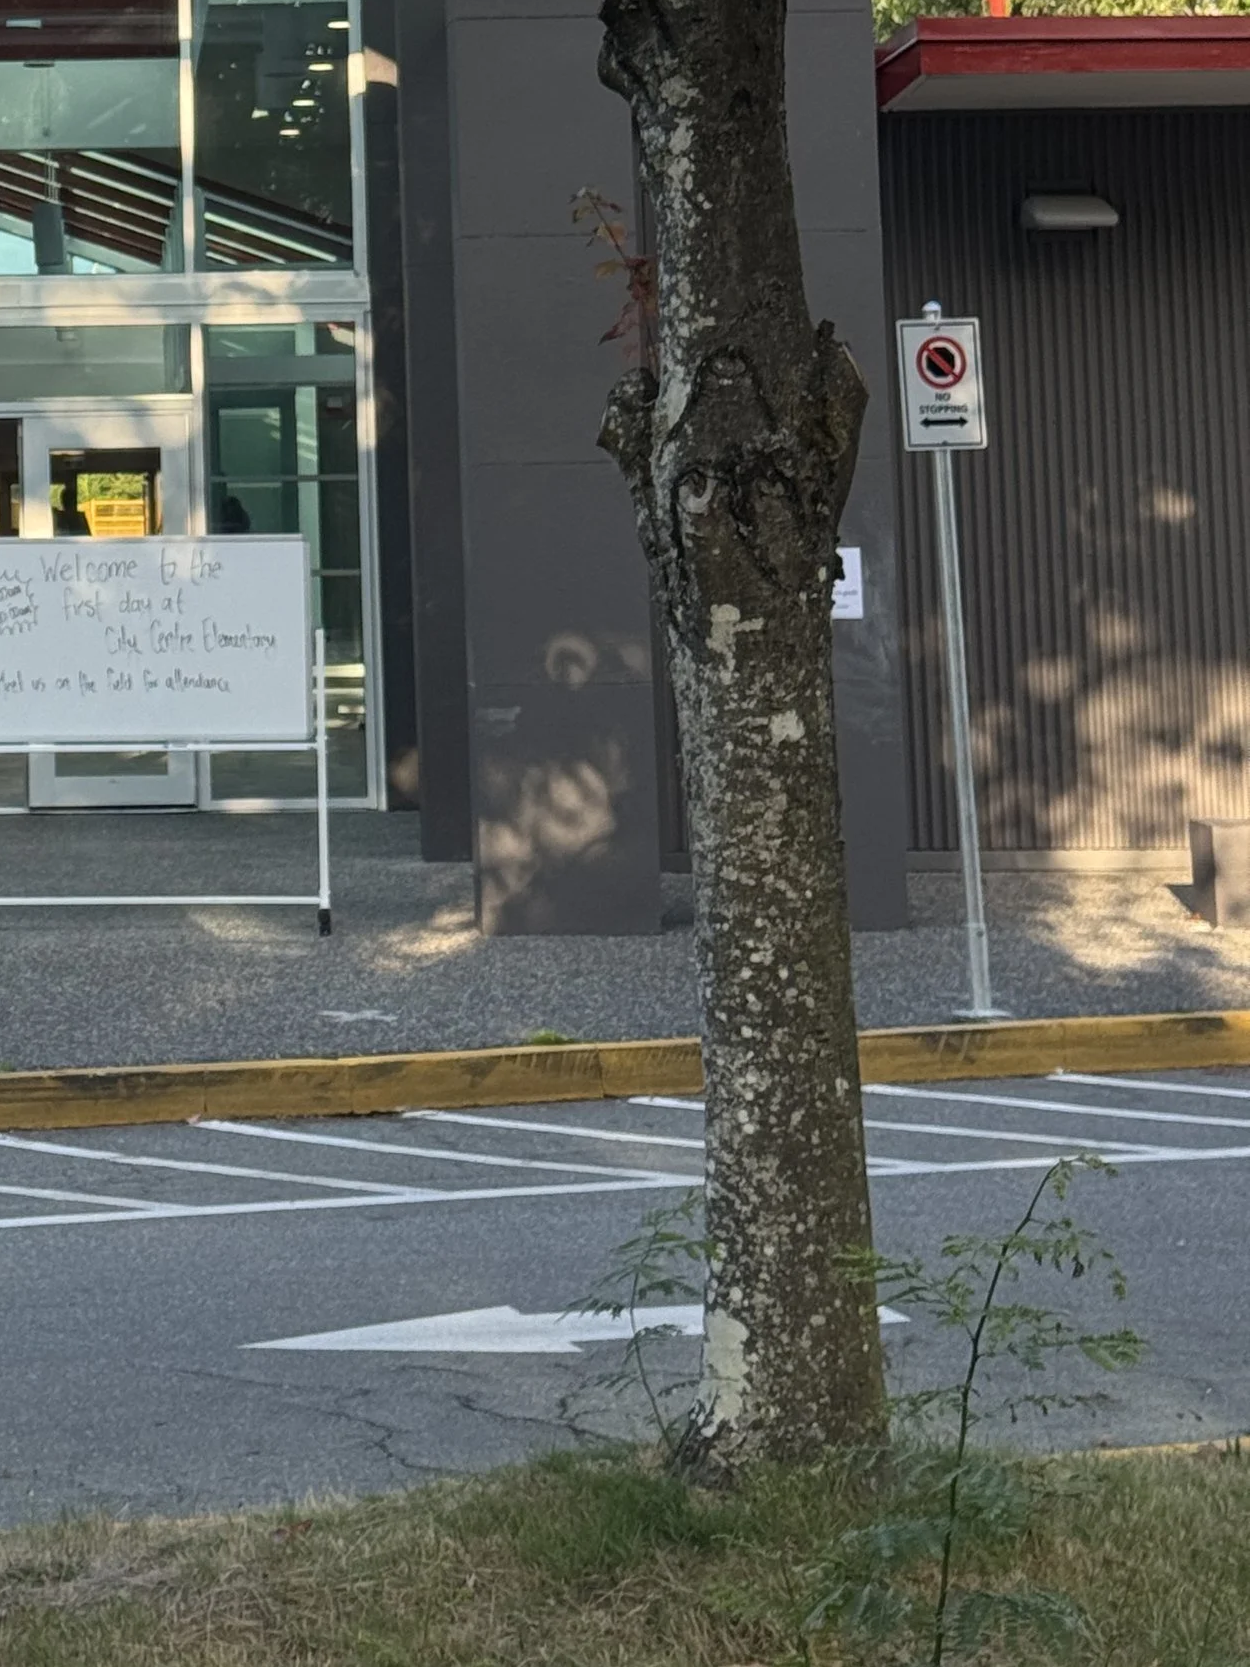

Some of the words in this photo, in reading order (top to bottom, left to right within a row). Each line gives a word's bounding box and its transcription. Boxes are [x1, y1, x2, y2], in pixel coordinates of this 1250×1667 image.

[918, 404, 968, 414] STOPPING
[934, 392, 951, 401] NO
[40, 552, 138, 583] Welcome
[159, 547, 177, 585] to
[189, 548, 223, 586] the
[63, 586, 103, 622] first
[118, 591, 151, 619] day
[161, 587, 184, 614] at
[104, 625, 143, 665] City
[150, 618, 195, 655] Centre
[31, 678, 46, 692] us
[78, 670, 97, 697] the
[143, 668, 159, 692] for
